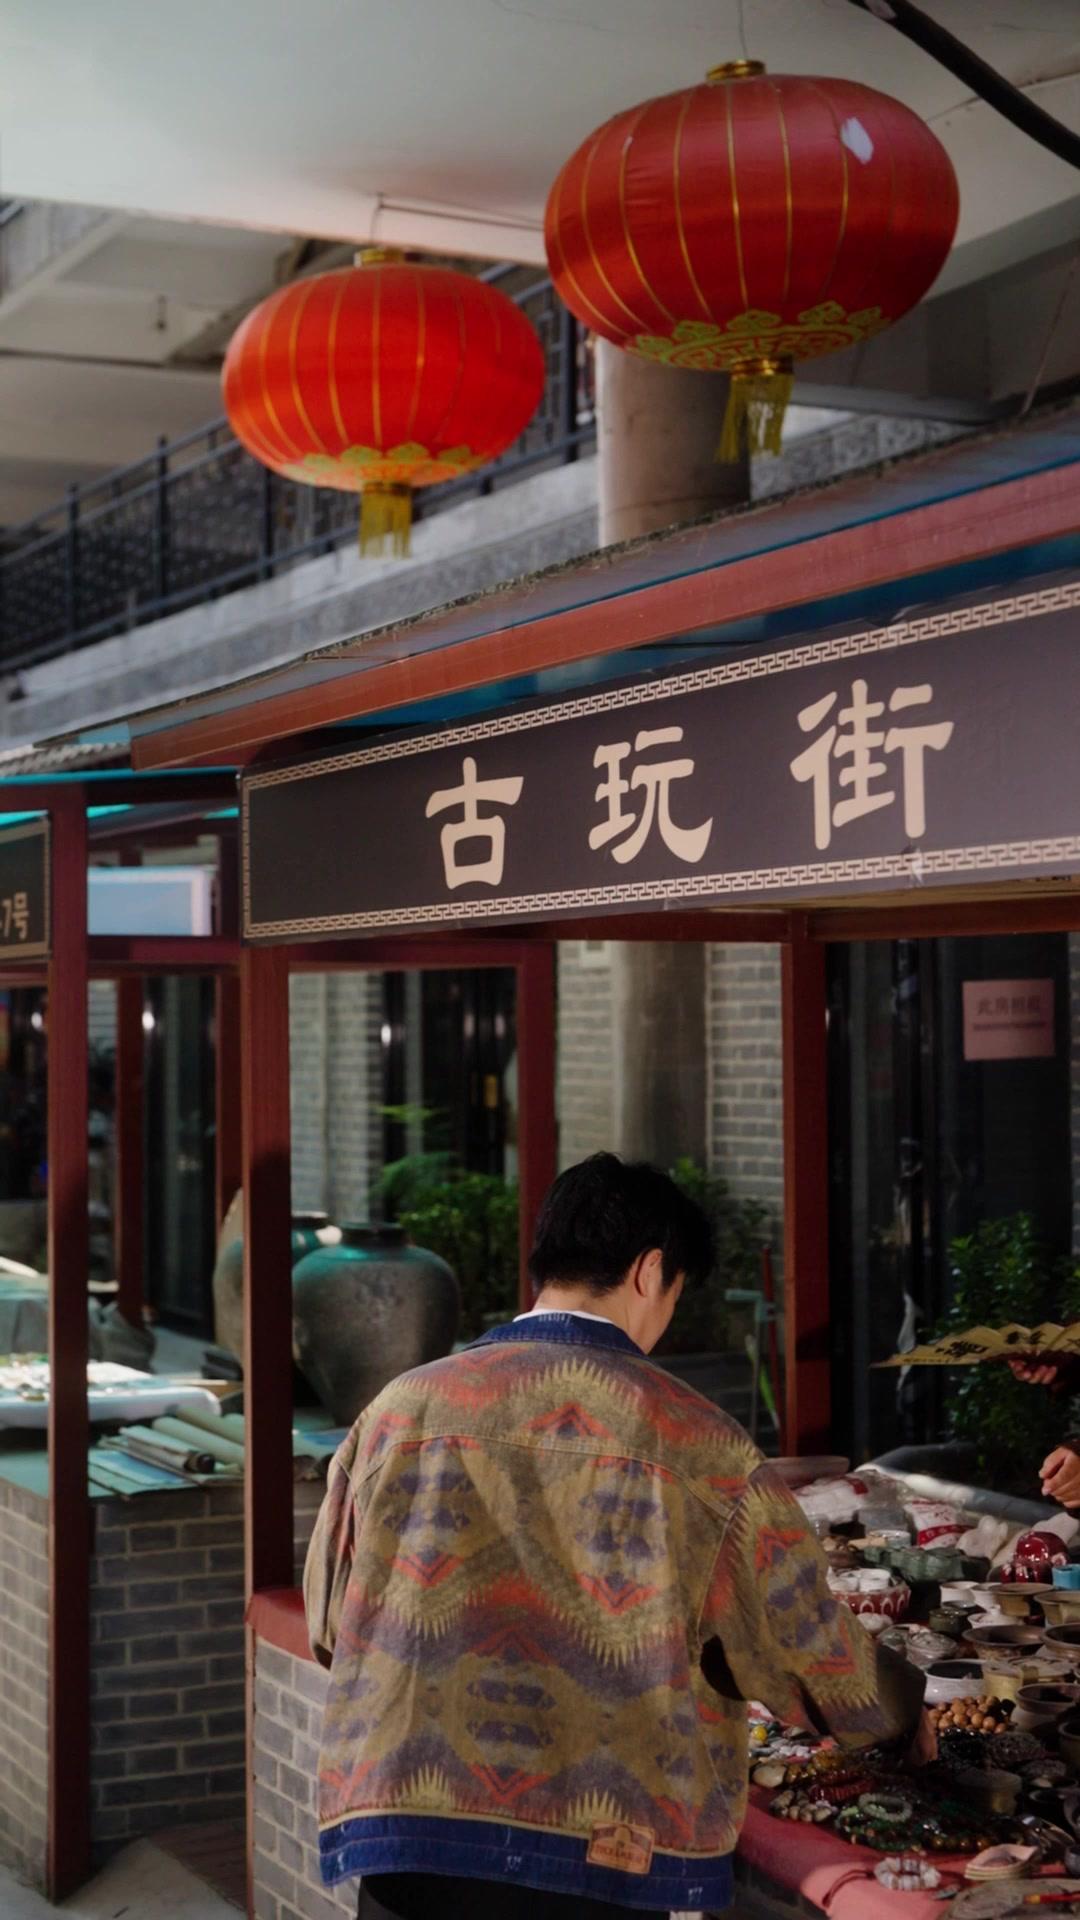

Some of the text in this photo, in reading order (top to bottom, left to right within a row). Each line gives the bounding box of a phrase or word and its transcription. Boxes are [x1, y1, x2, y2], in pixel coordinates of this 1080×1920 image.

[425, 679, 955, 890] 古玩街
[0, 892, 29, 939] 7号
